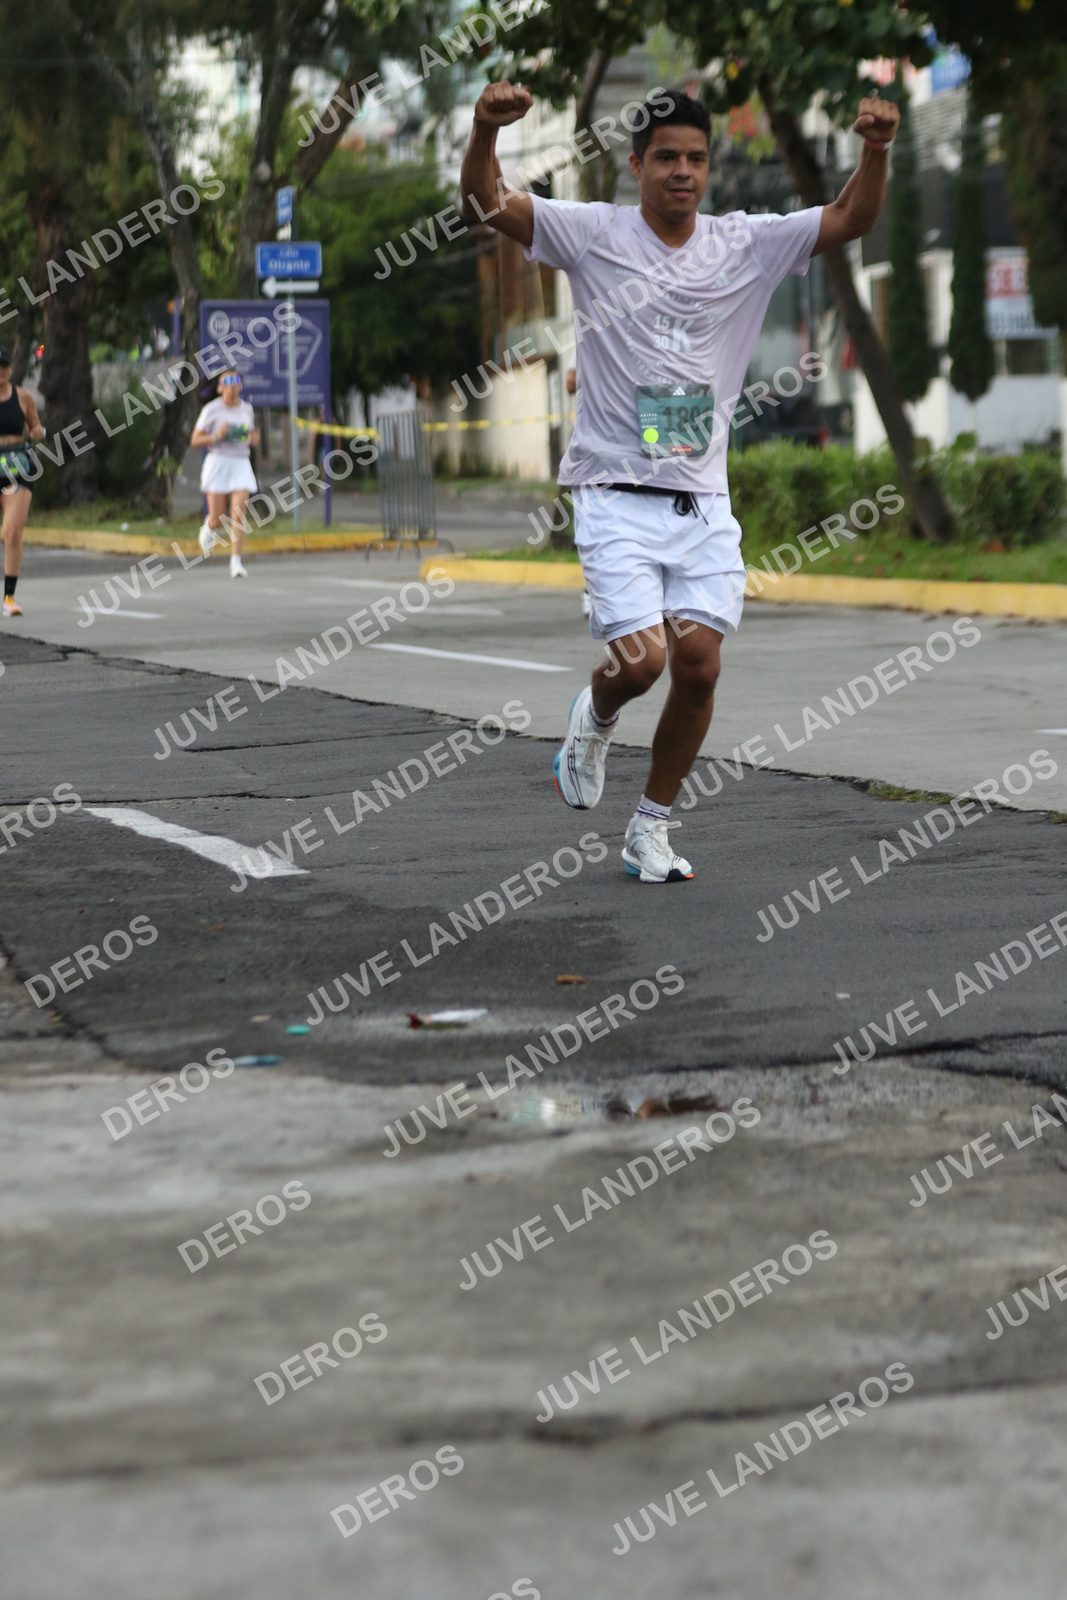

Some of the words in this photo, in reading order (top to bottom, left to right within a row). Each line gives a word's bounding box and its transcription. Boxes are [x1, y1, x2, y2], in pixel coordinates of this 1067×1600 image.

[654, 314, 670, 330] 15
[654, 335, 669, 349] 30
[672, 319, 695, 352] K
